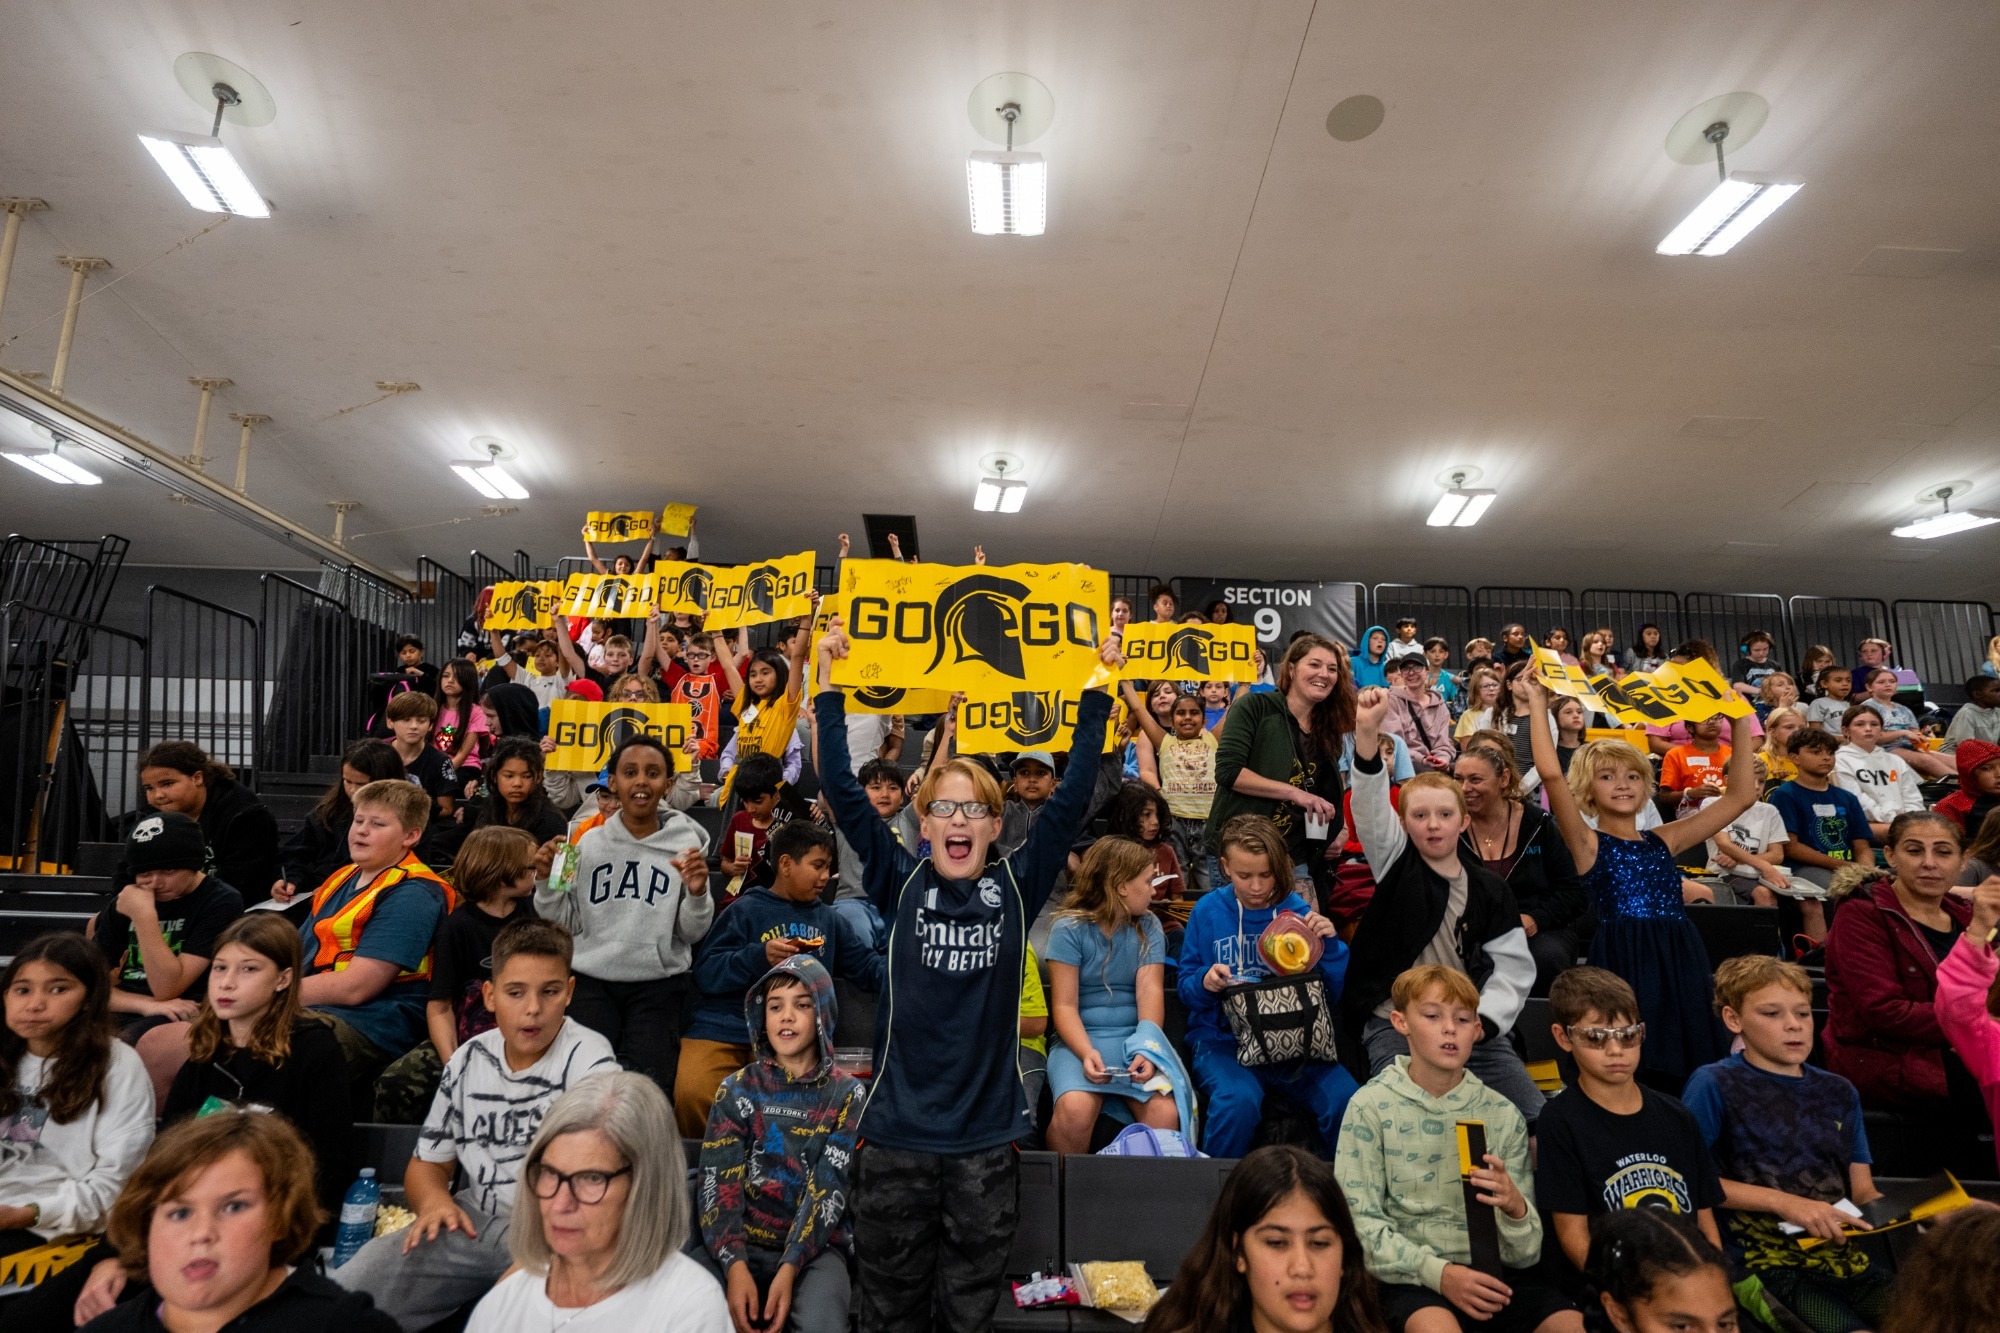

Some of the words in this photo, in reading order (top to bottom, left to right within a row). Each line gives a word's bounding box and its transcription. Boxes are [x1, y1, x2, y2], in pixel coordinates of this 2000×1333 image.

[589, 520, 609, 532] GO
[629, 519, 649, 531] GO
[565, 585, 596, 602] GO
[624, 586, 654, 603] GO
[659, 576, 680, 595] GO
[711, 585, 743, 609] GO
[774, 571, 808, 599] GO
[1224, 586, 1312, 607] SECTION
[848, 596, 932, 644] GO
[1021, 602, 1100, 649] GO
[1253, 607, 1282, 643] 9
[1126, 639, 1166, 660] GO
[1209, 641, 1250, 661] GO
[1649, 676, 1722, 705] GO
[965, 701, 1012, 730] GO
[555, 721, 598, 748] GO
[588, 860, 671, 907] GAP
[915, 907, 1005, 947] Emirat
[921, 943, 945, 969] FLY
[764, 1106, 781, 1114] ZOO
[782, 1108, 802, 1117] YORK
[1615, 1152, 1668, 1169] WATERLOO
[1603, 1166, 1693, 1214] WARRIORS
